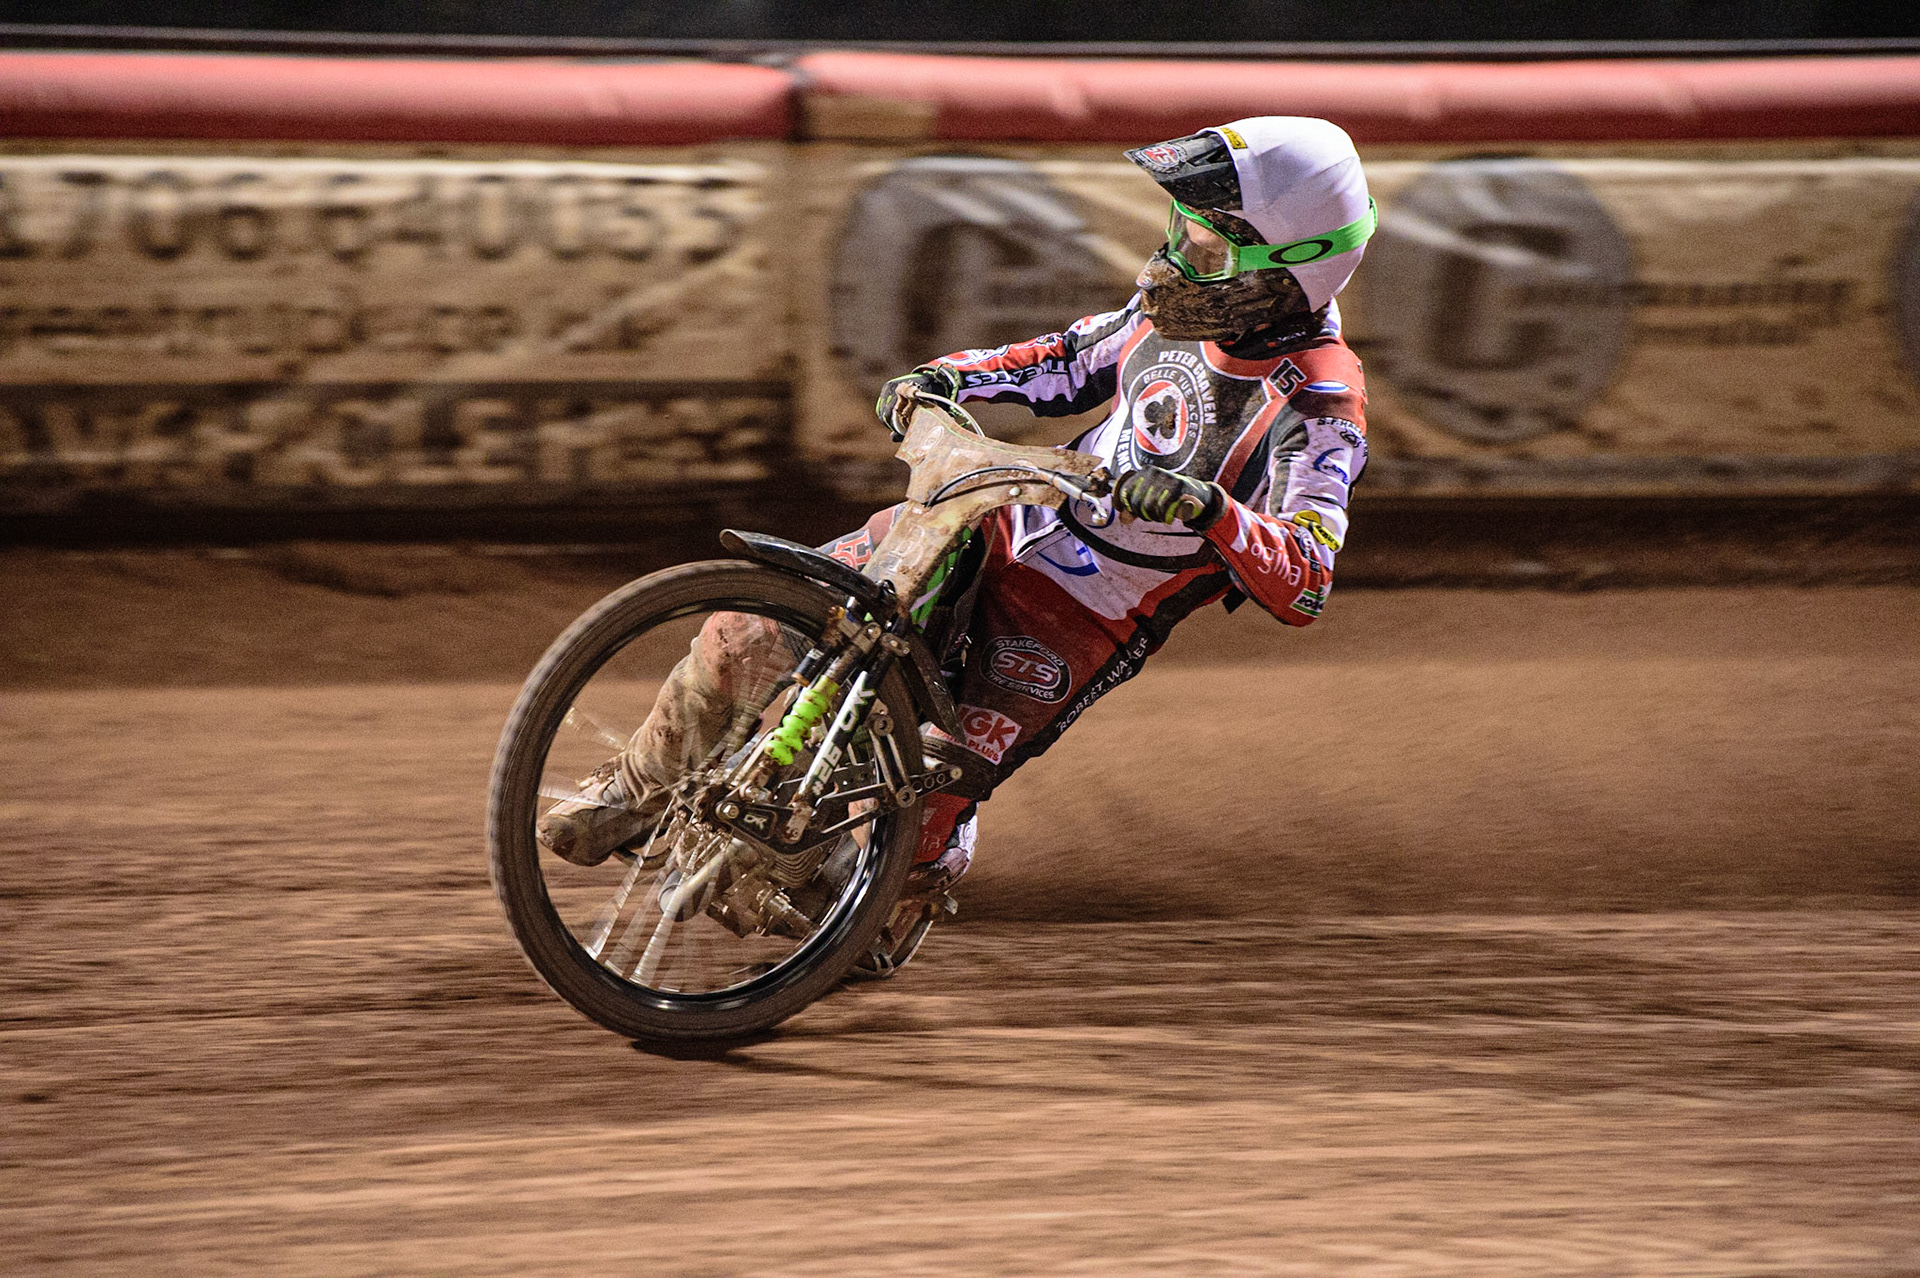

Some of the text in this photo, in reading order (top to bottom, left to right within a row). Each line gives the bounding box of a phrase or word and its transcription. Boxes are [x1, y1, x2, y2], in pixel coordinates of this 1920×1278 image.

[1157, 350, 1217, 425] PETER CRAVEN
[1270, 357, 1306, 398] 15
[1143, 369, 1199, 439] BELLE VUE ACES
[993, 651, 1058, 682] STS
[995, 639, 1065, 668] STAKEFORD
[1009, 681, 1055, 700] SERVICES
[959, 707, 1017, 752] GK
[968, 740, 1000, 763] PLUGS
